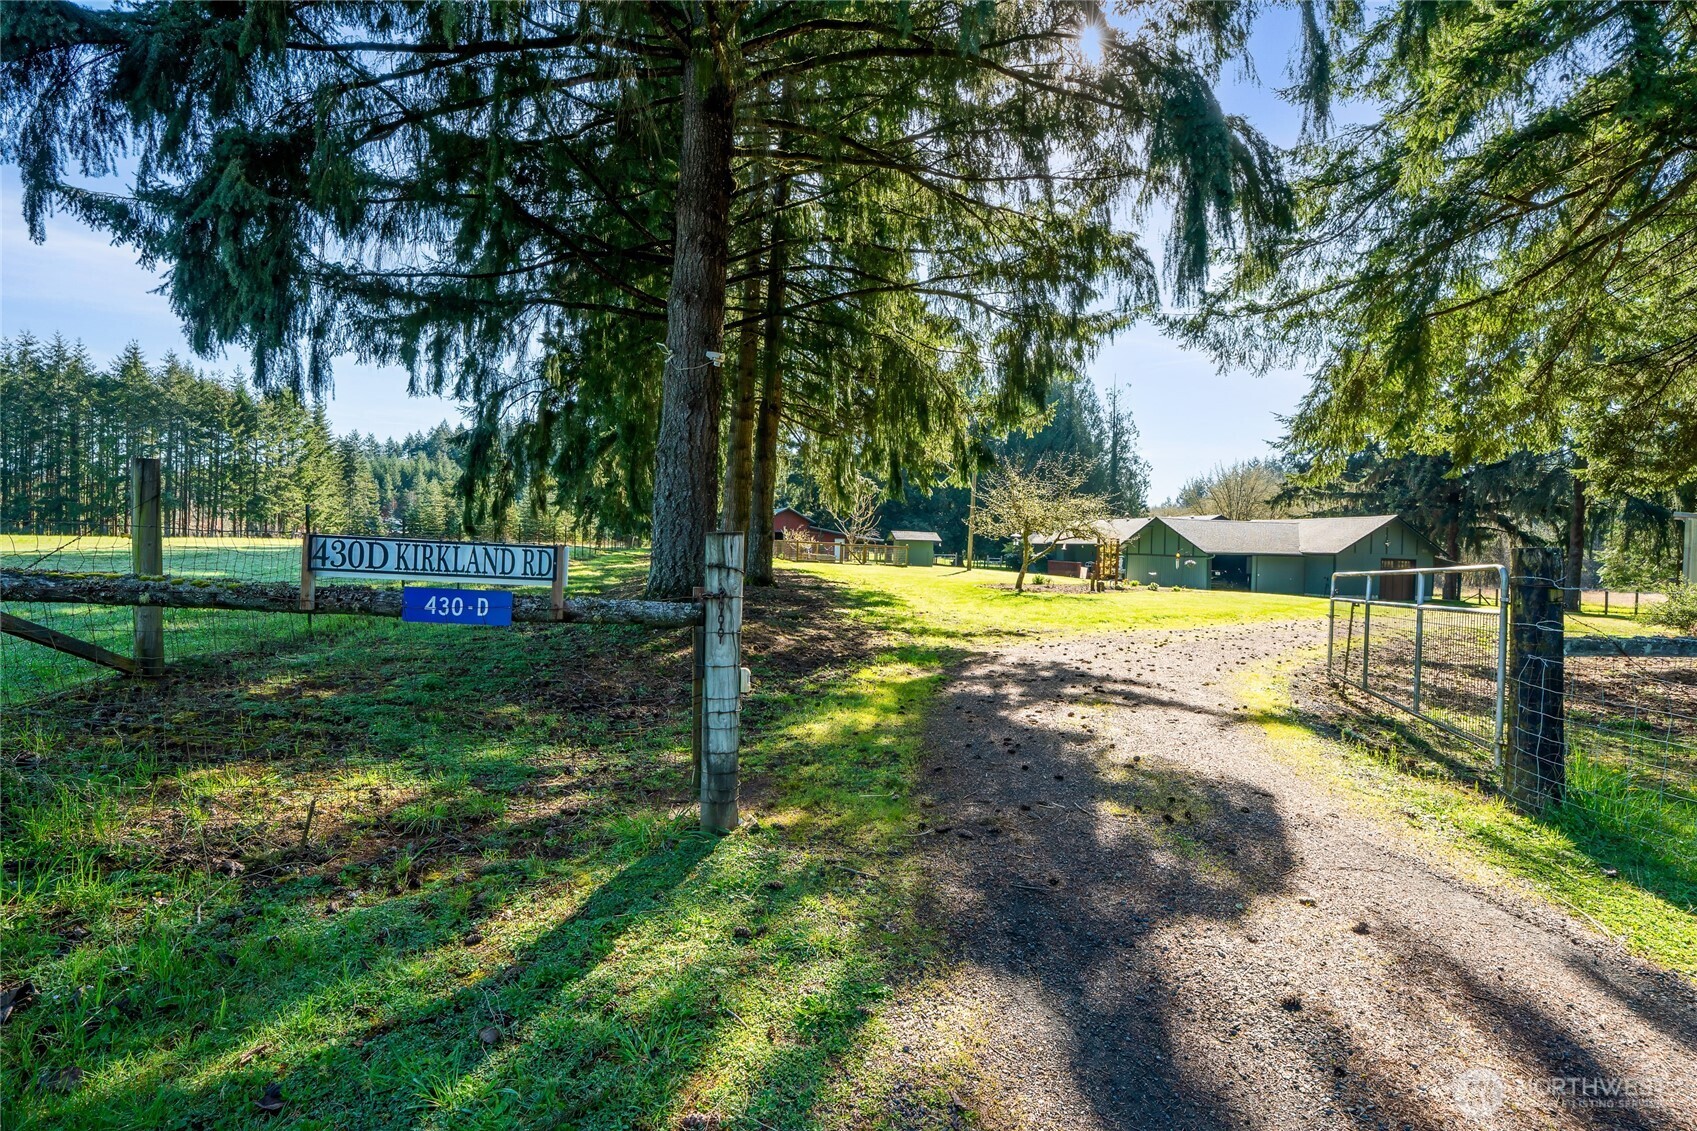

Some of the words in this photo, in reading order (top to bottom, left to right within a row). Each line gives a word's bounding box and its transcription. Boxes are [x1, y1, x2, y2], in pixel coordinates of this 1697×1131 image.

[312, 538, 389, 569] 430D
[395, 542, 515, 576] KIRKLAND
[522, 548, 552, 577] RD
